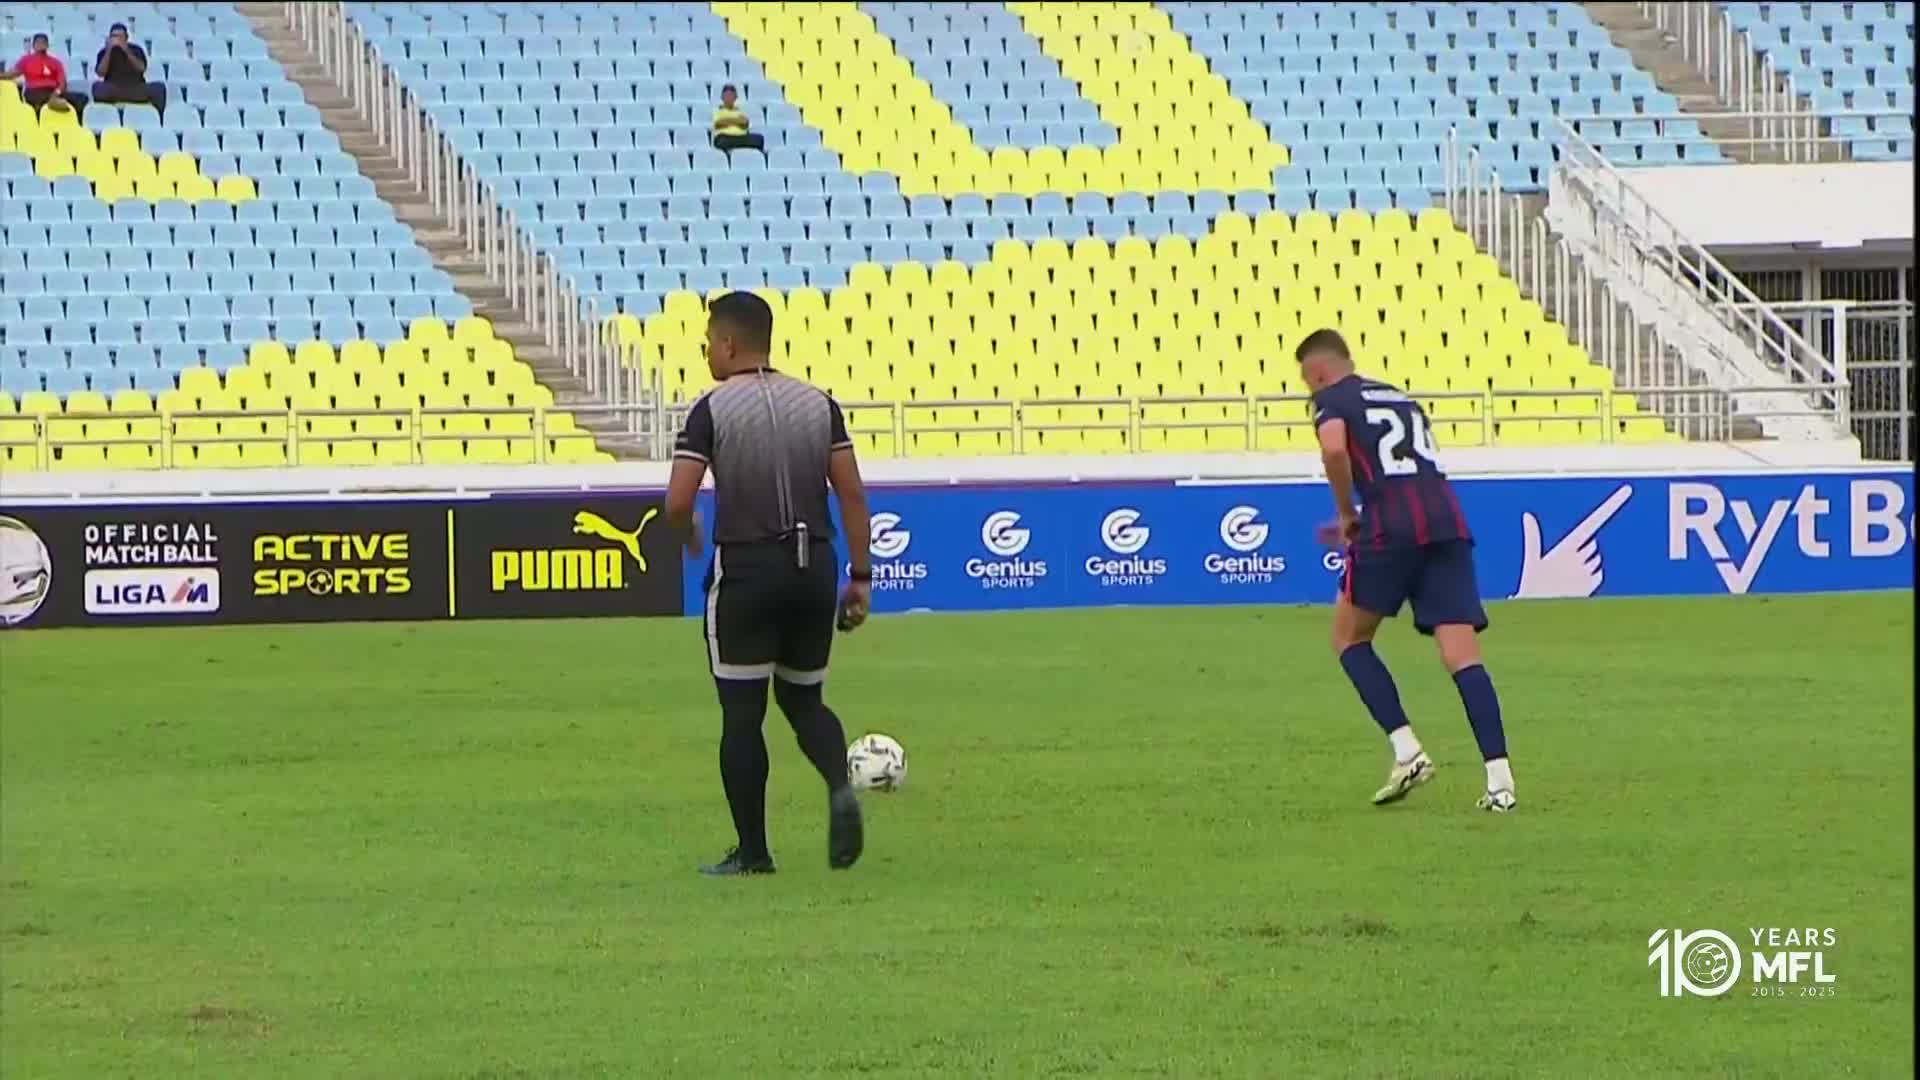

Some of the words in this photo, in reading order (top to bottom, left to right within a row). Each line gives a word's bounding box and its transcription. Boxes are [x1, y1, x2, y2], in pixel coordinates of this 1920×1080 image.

[85, 523, 218, 543] OFFICIAL
[1669, 482, 1830, 594] Ryt
[85, 544, 160, 564] MATCH
[163, 544, 218, 563] BALL
[1204, 552, 1285, 573] Genius
[492, 549, 623, 591] PUMA
[846, 560, 928, 579] enius
[966, 557, 1047, 577] Genius
[1085, 554, 1167, 575] Genius
[982, 577, 1034, 588] SPORTS
[1101, 575, 1153, 586] SPORTS
[1220, 572, 1272, 584] SPORTS
[96, 584, 166, 604] LIGA
